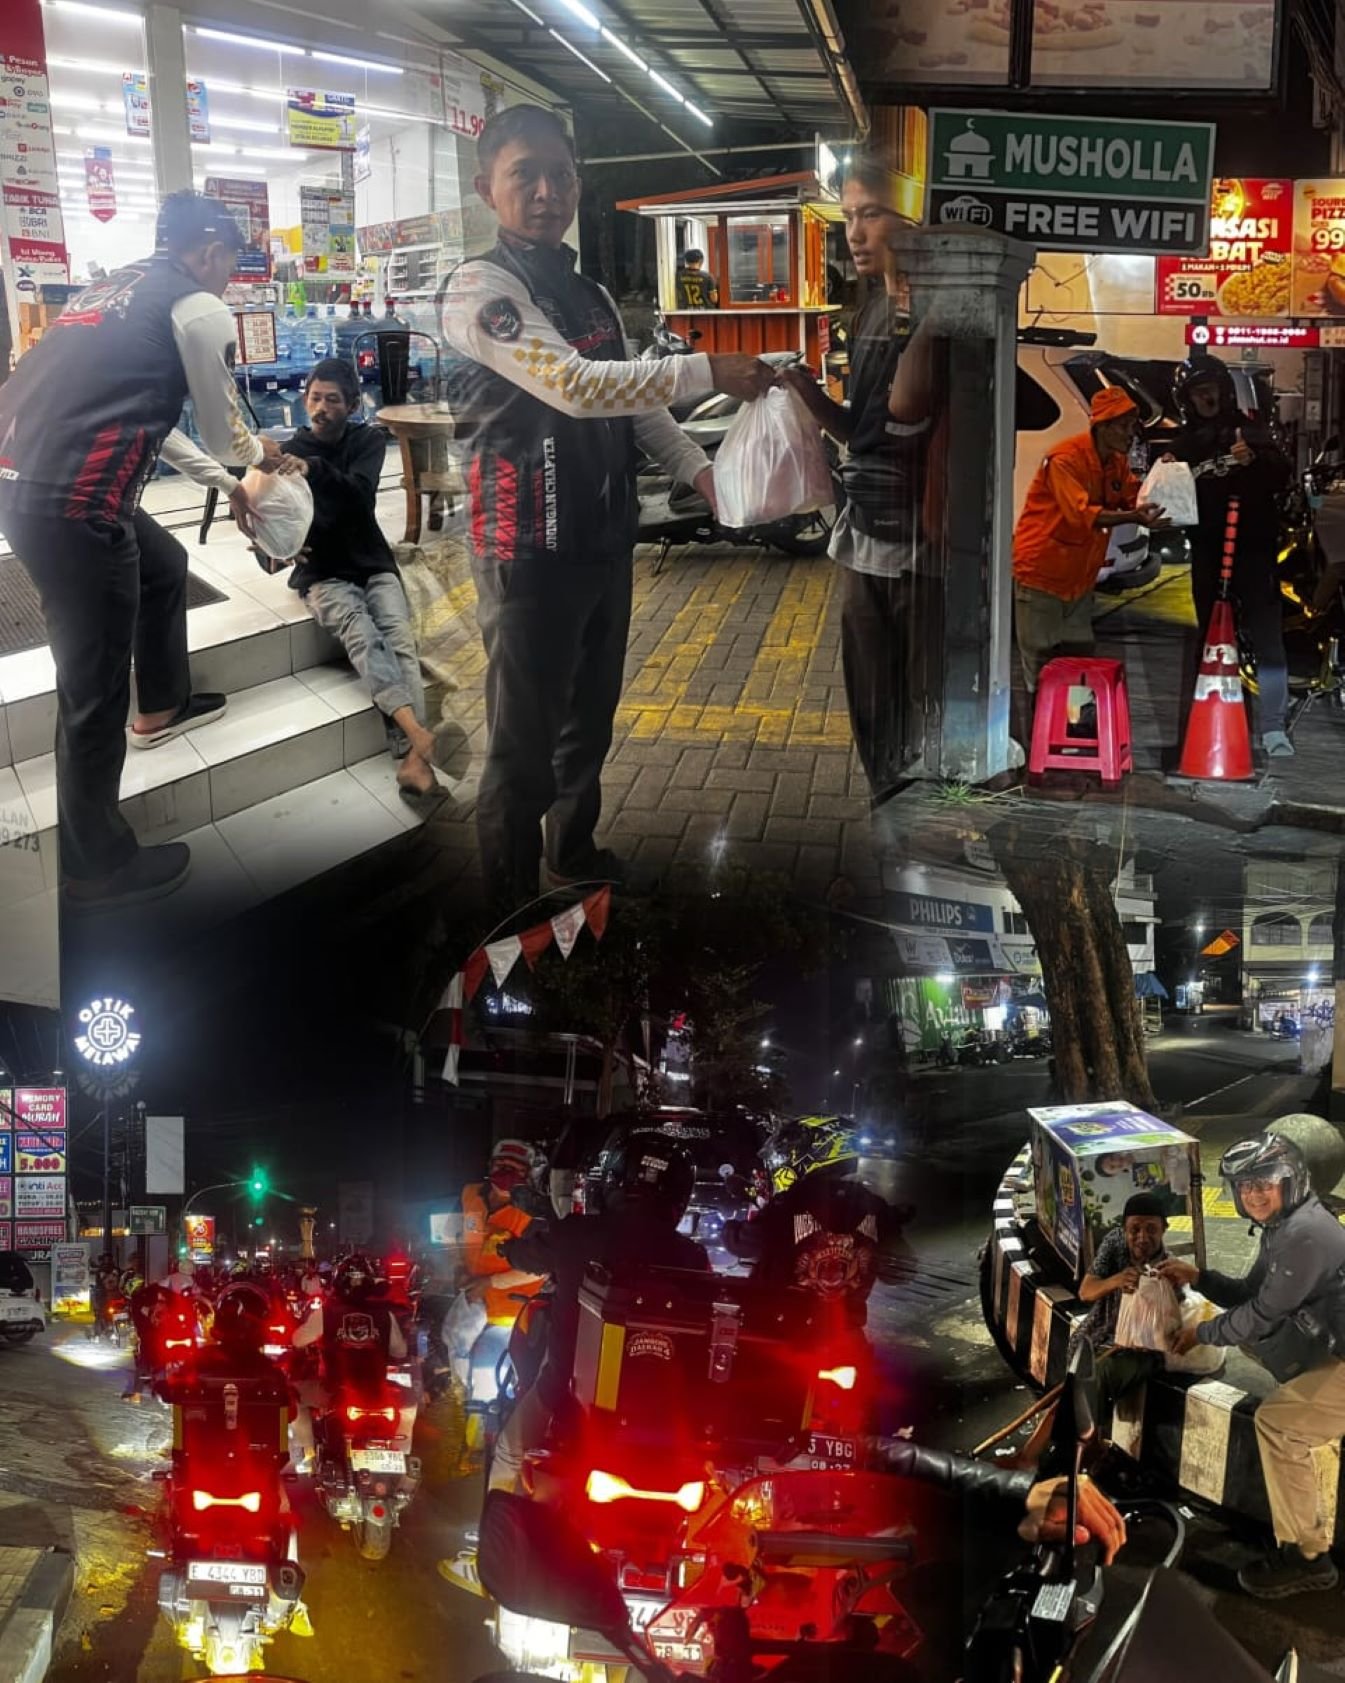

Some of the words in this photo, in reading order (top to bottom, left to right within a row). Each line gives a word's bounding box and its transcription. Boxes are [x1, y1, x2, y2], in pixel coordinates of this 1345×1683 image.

[1005, 133, 1197, 183] MUSHOLLA
[1005, 202, 1099, 236] FREE
[1111, 208, 1195, 242] WIFI
[683, 284, 703, 305] 12
[1177, 282, 1201, 298] 50
[543, 437, 557, 493] CHAPTER
[909, 898, 963, 926] PHILIPS
[78, 998, 135, 1022] OPTIK
[21, 1094, 61, 1102] MEMORY
[28, 1103, 54, 1111] CARD
[20, 1158, 60, 1171] 5.000
[825, 1440, 853, 1458] YBG
